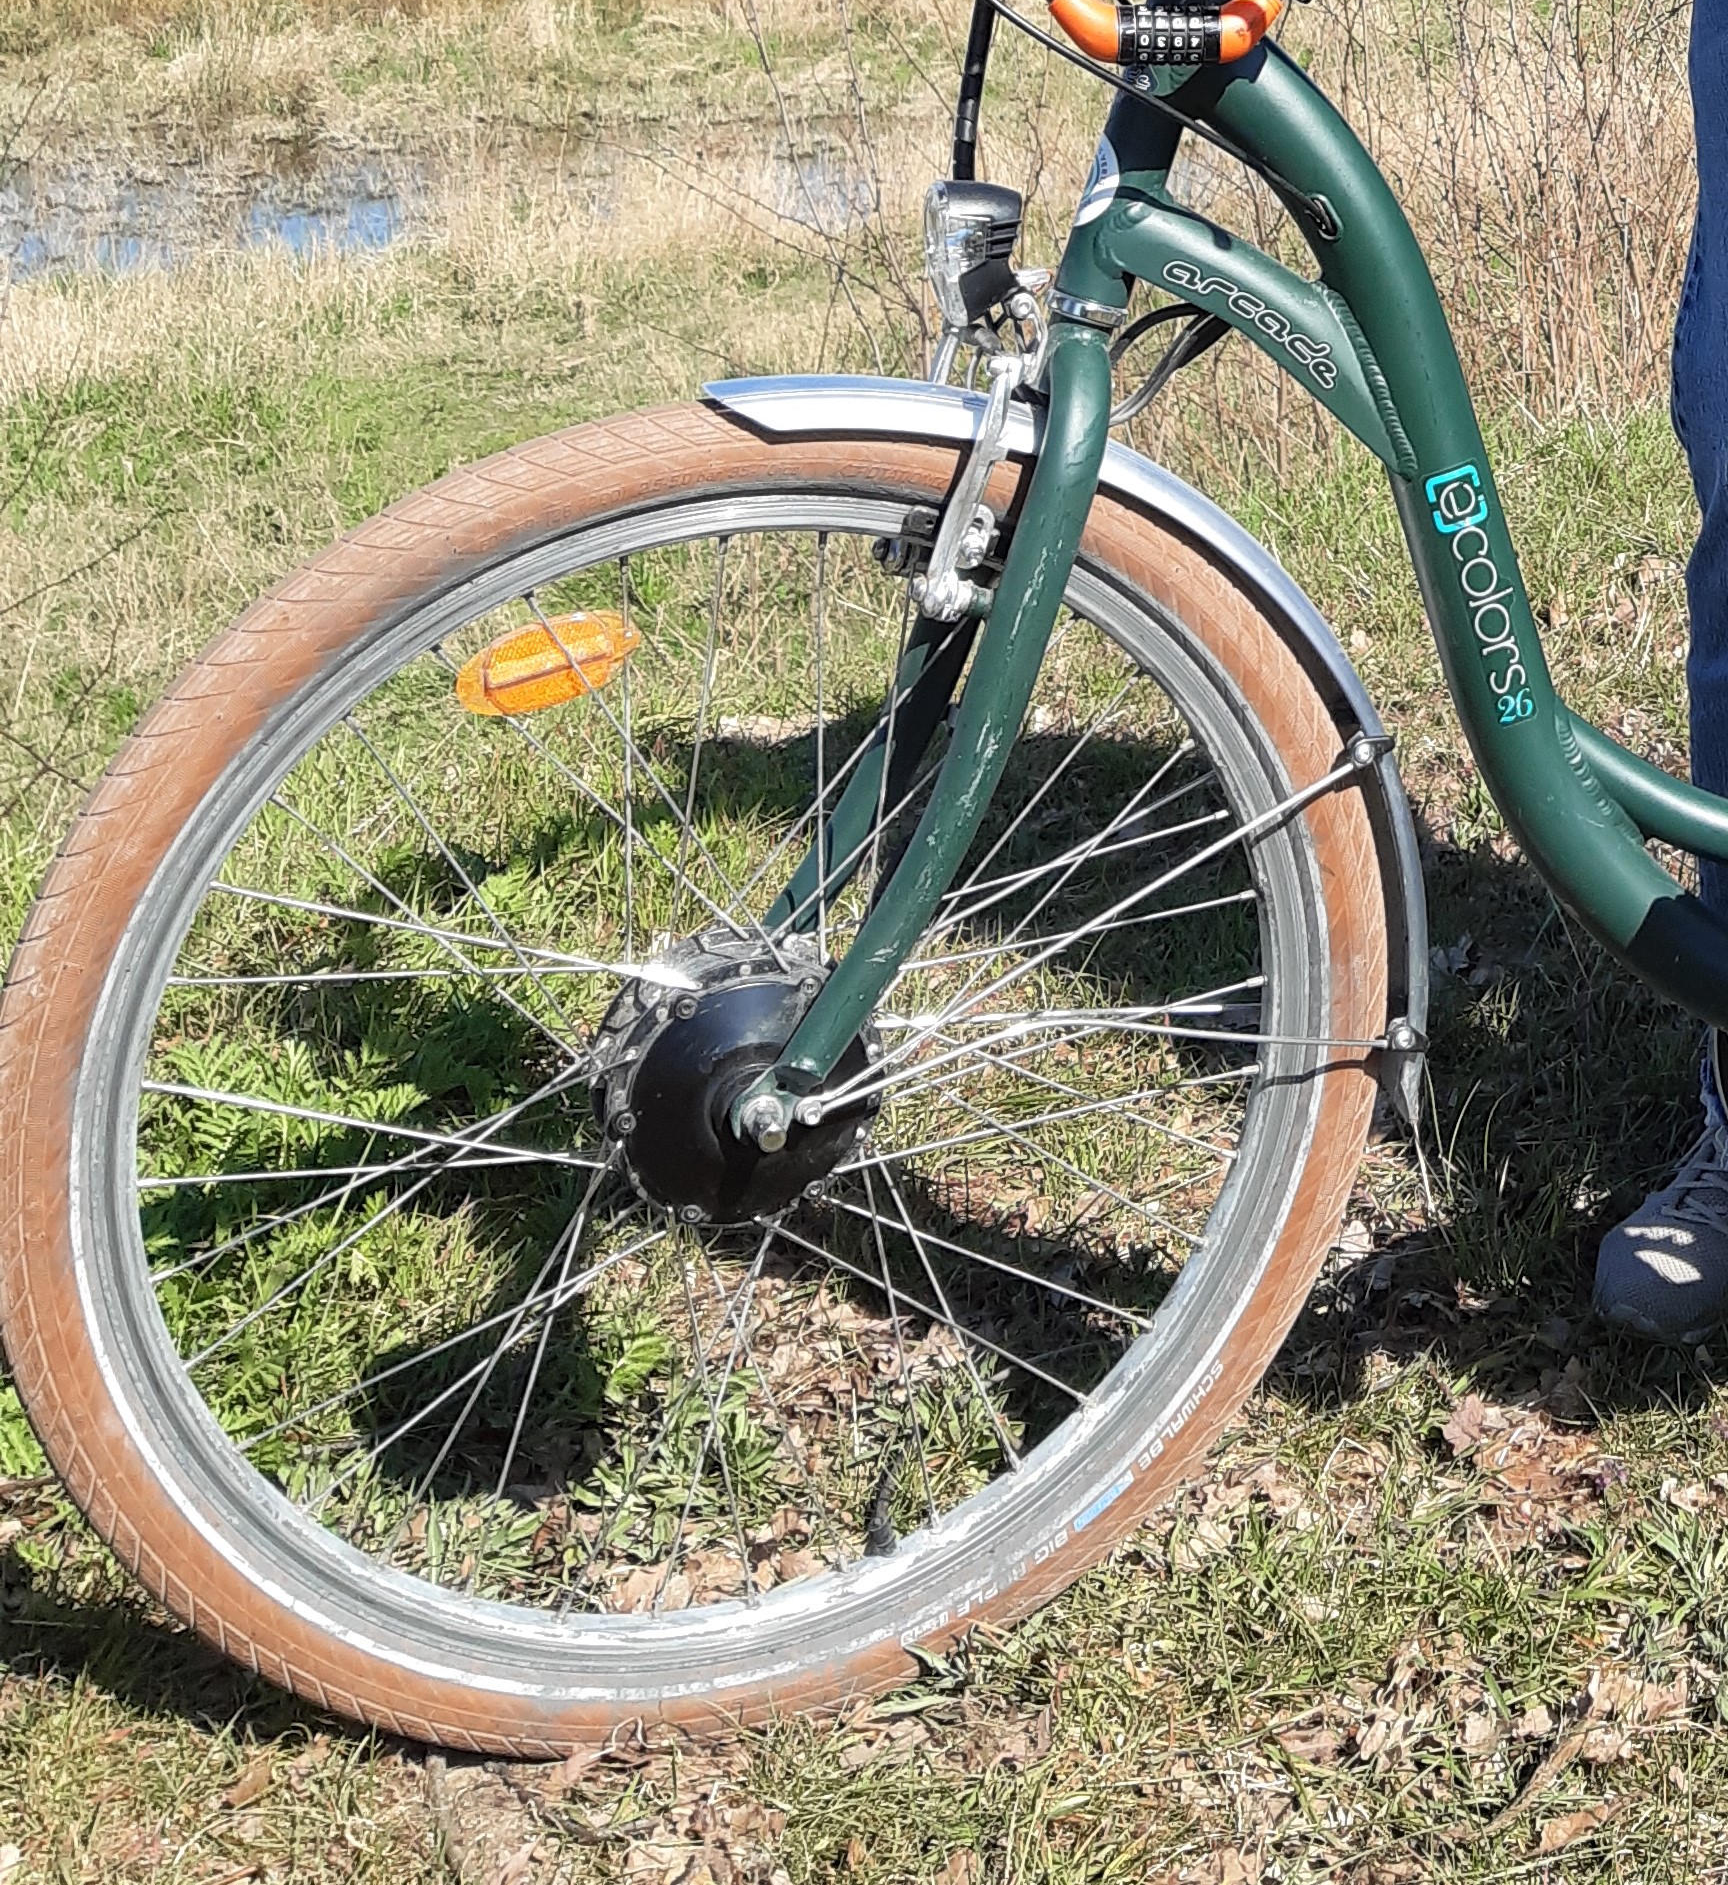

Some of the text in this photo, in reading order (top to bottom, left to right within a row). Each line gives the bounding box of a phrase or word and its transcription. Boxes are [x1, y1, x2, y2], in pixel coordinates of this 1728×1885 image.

[1162, 260, 1340, 391] arcade
[1496, 687, 1535, 726] 26
[1136, 1359, 1225, 1471] SCHWALBE
[956, 1527, 1069, 1617] BIG APLE
